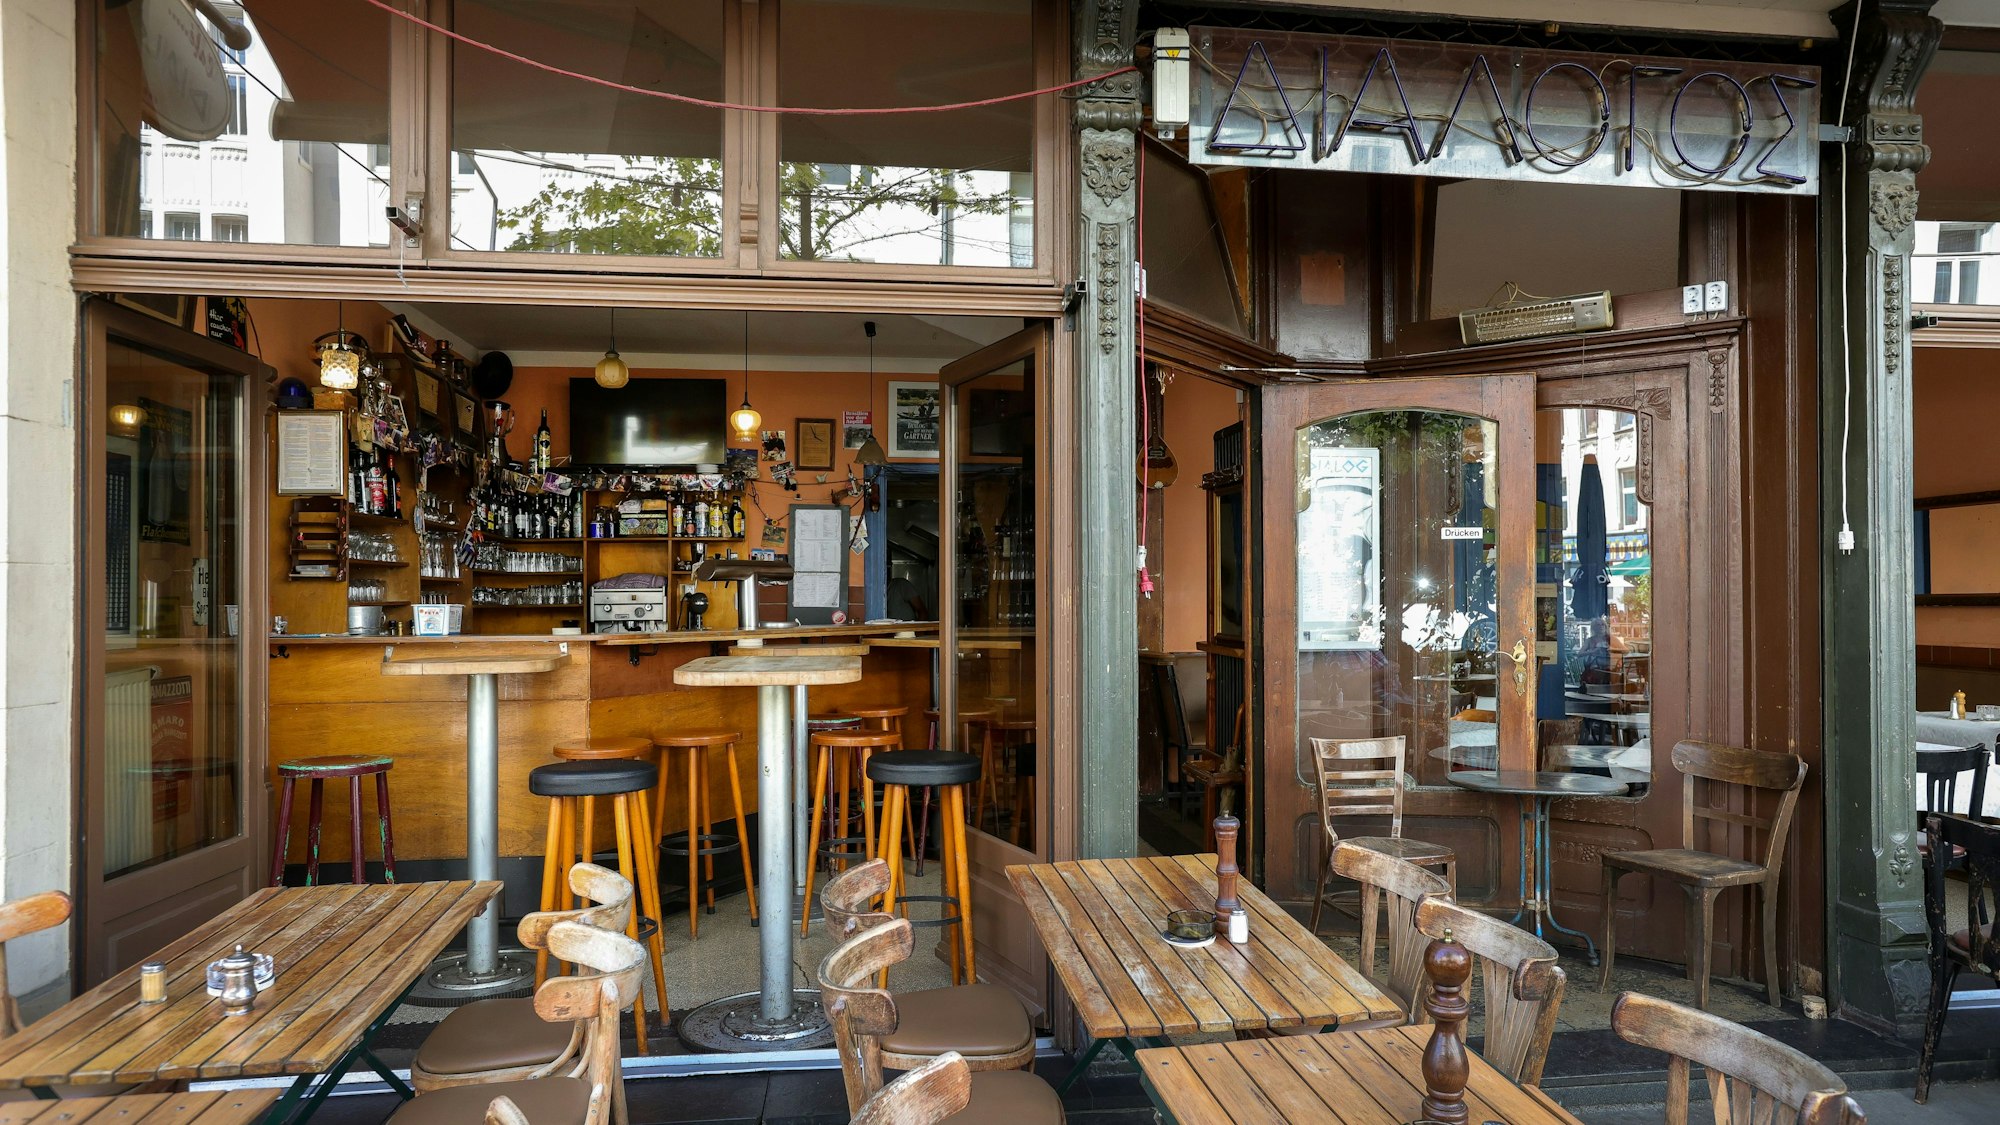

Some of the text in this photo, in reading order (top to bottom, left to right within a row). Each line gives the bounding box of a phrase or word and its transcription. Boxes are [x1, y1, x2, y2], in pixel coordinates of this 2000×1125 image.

[1208, 40, 1817, 184] ΔΙΑΛΟΓΟΣ
[1444, 529, 1480, 537] Drücken
[198, 567, 208, 584] He
[151, 680, 191, 699] AMAZZOTTI
[152, 715, 185, 733] AMARO
